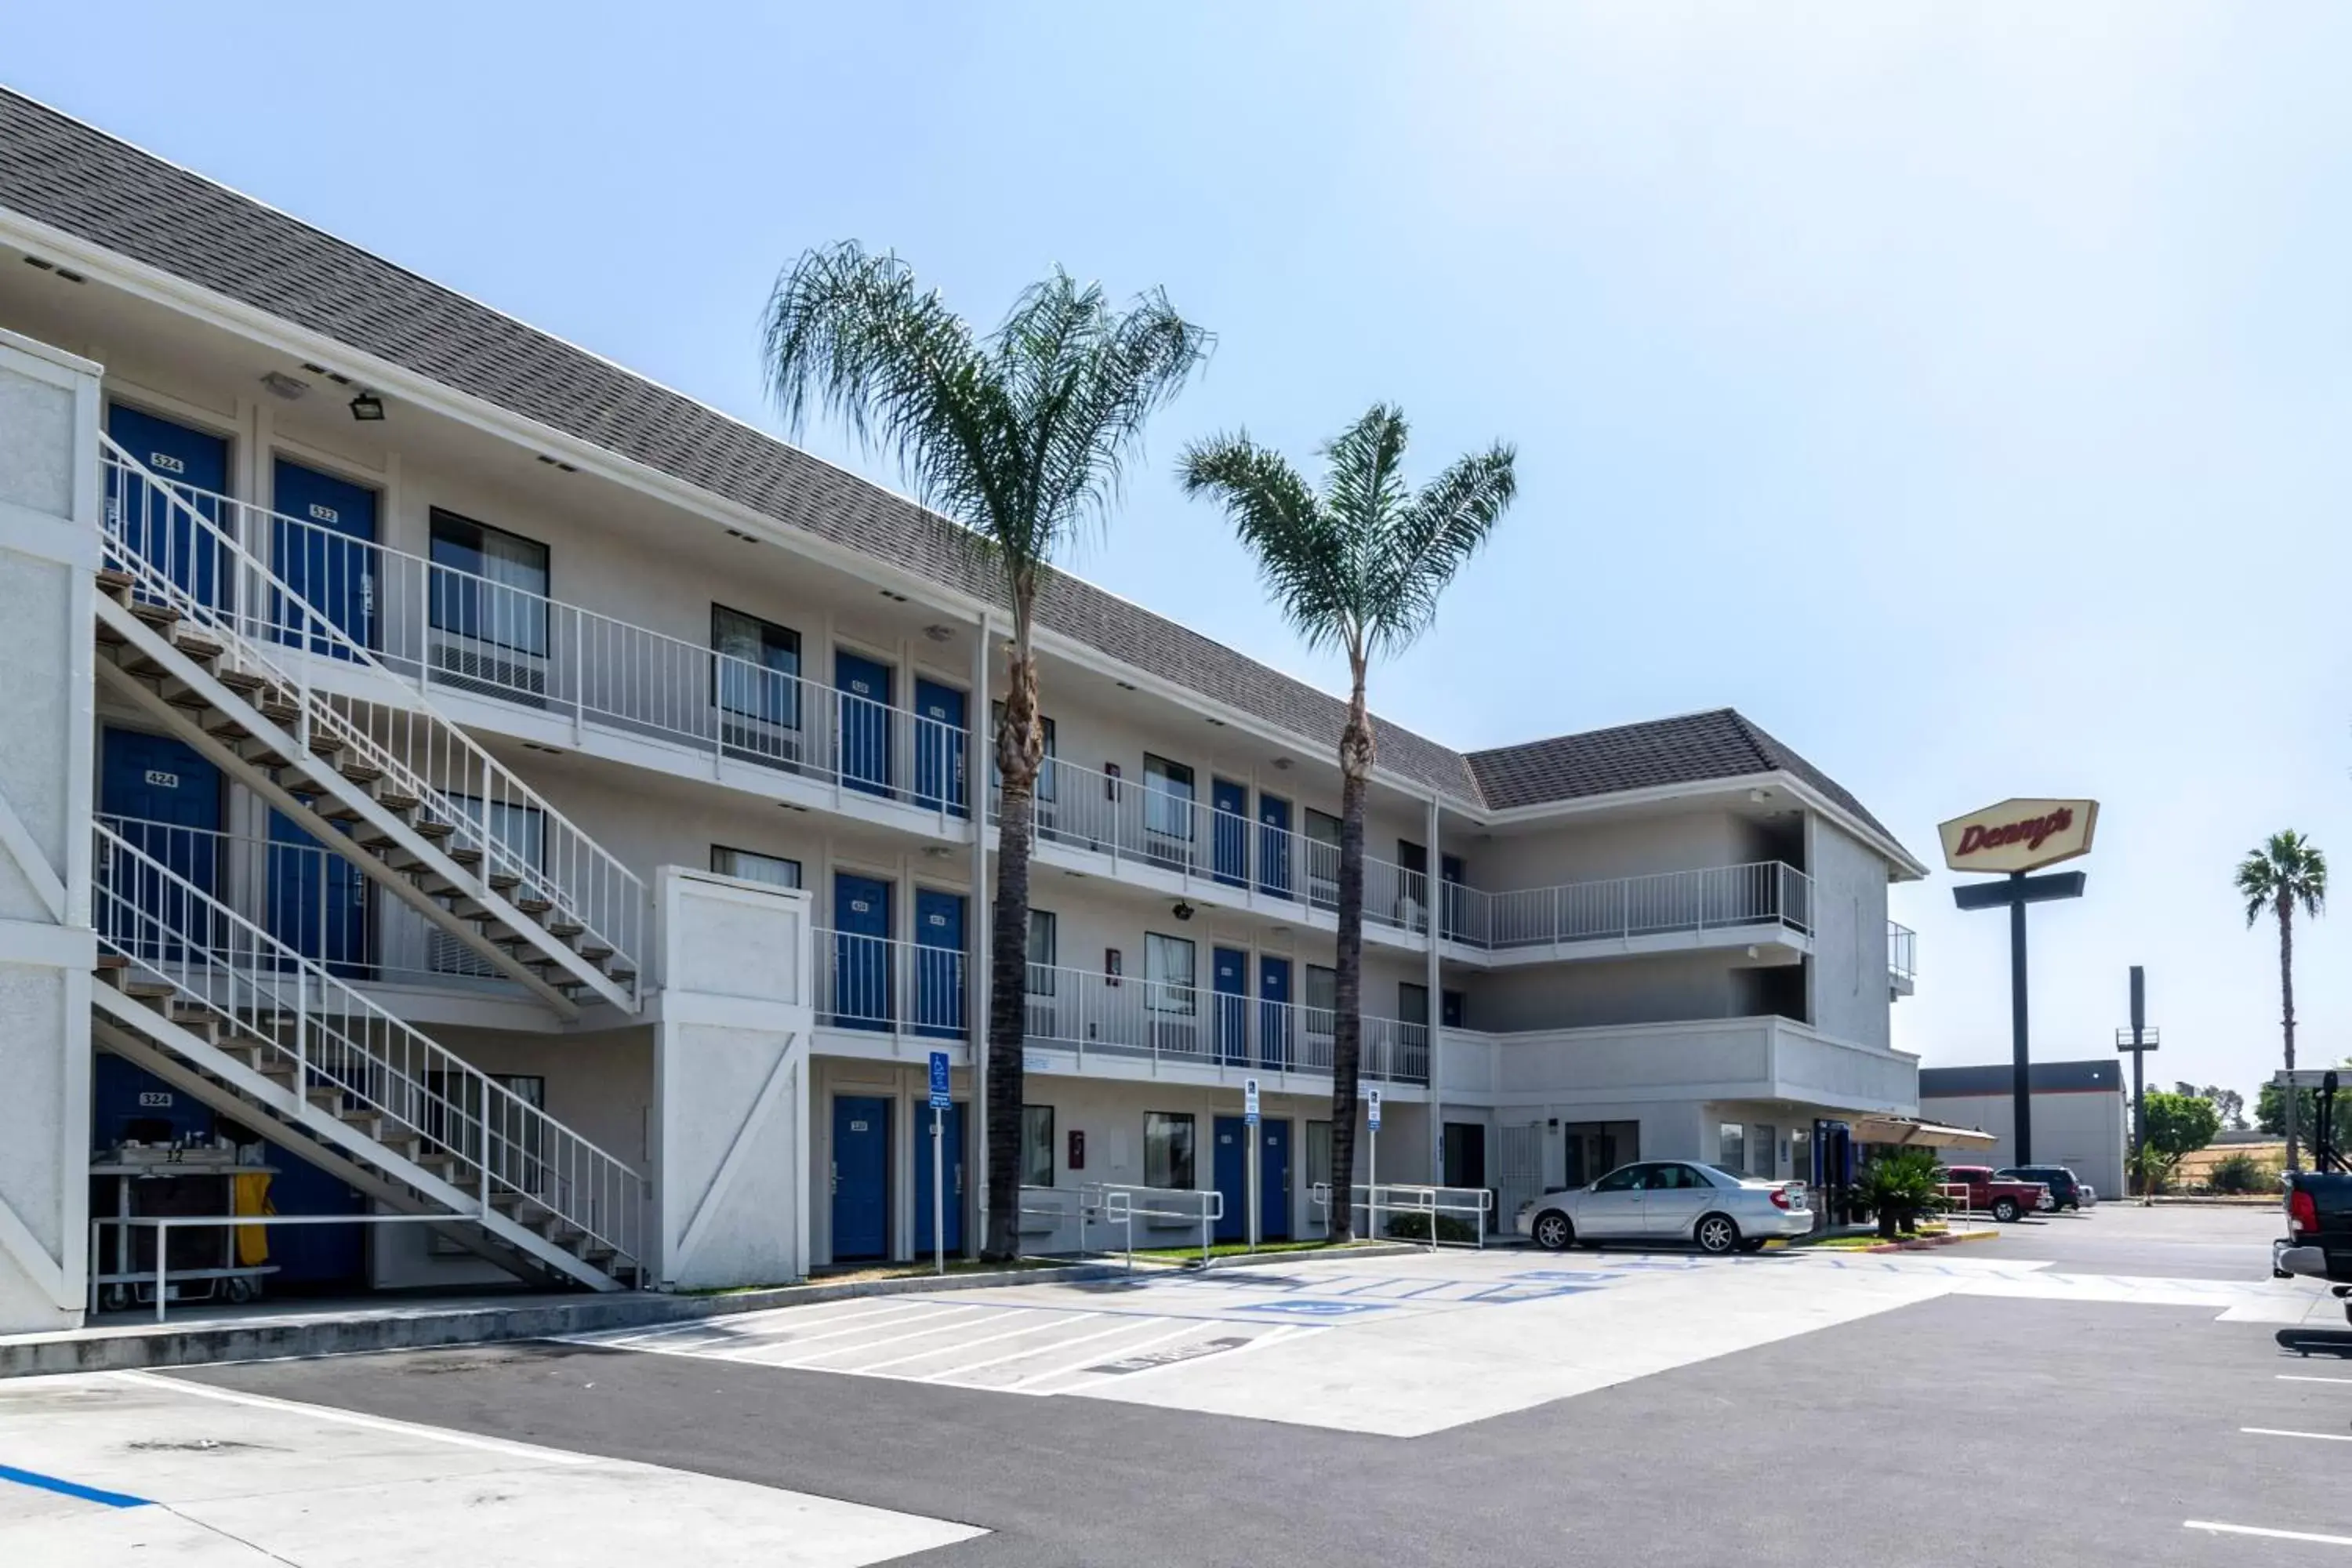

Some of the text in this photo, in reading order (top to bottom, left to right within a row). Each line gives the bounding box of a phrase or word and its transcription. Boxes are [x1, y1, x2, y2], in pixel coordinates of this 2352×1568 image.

[153, 453, 180, 471] 524
[147, 772, 175, 786] 424
[1955, 806, 2074, 856] Denny's
[143, 1093, 169, 1105] 324
[166, 1149, 183, 1163] 12
